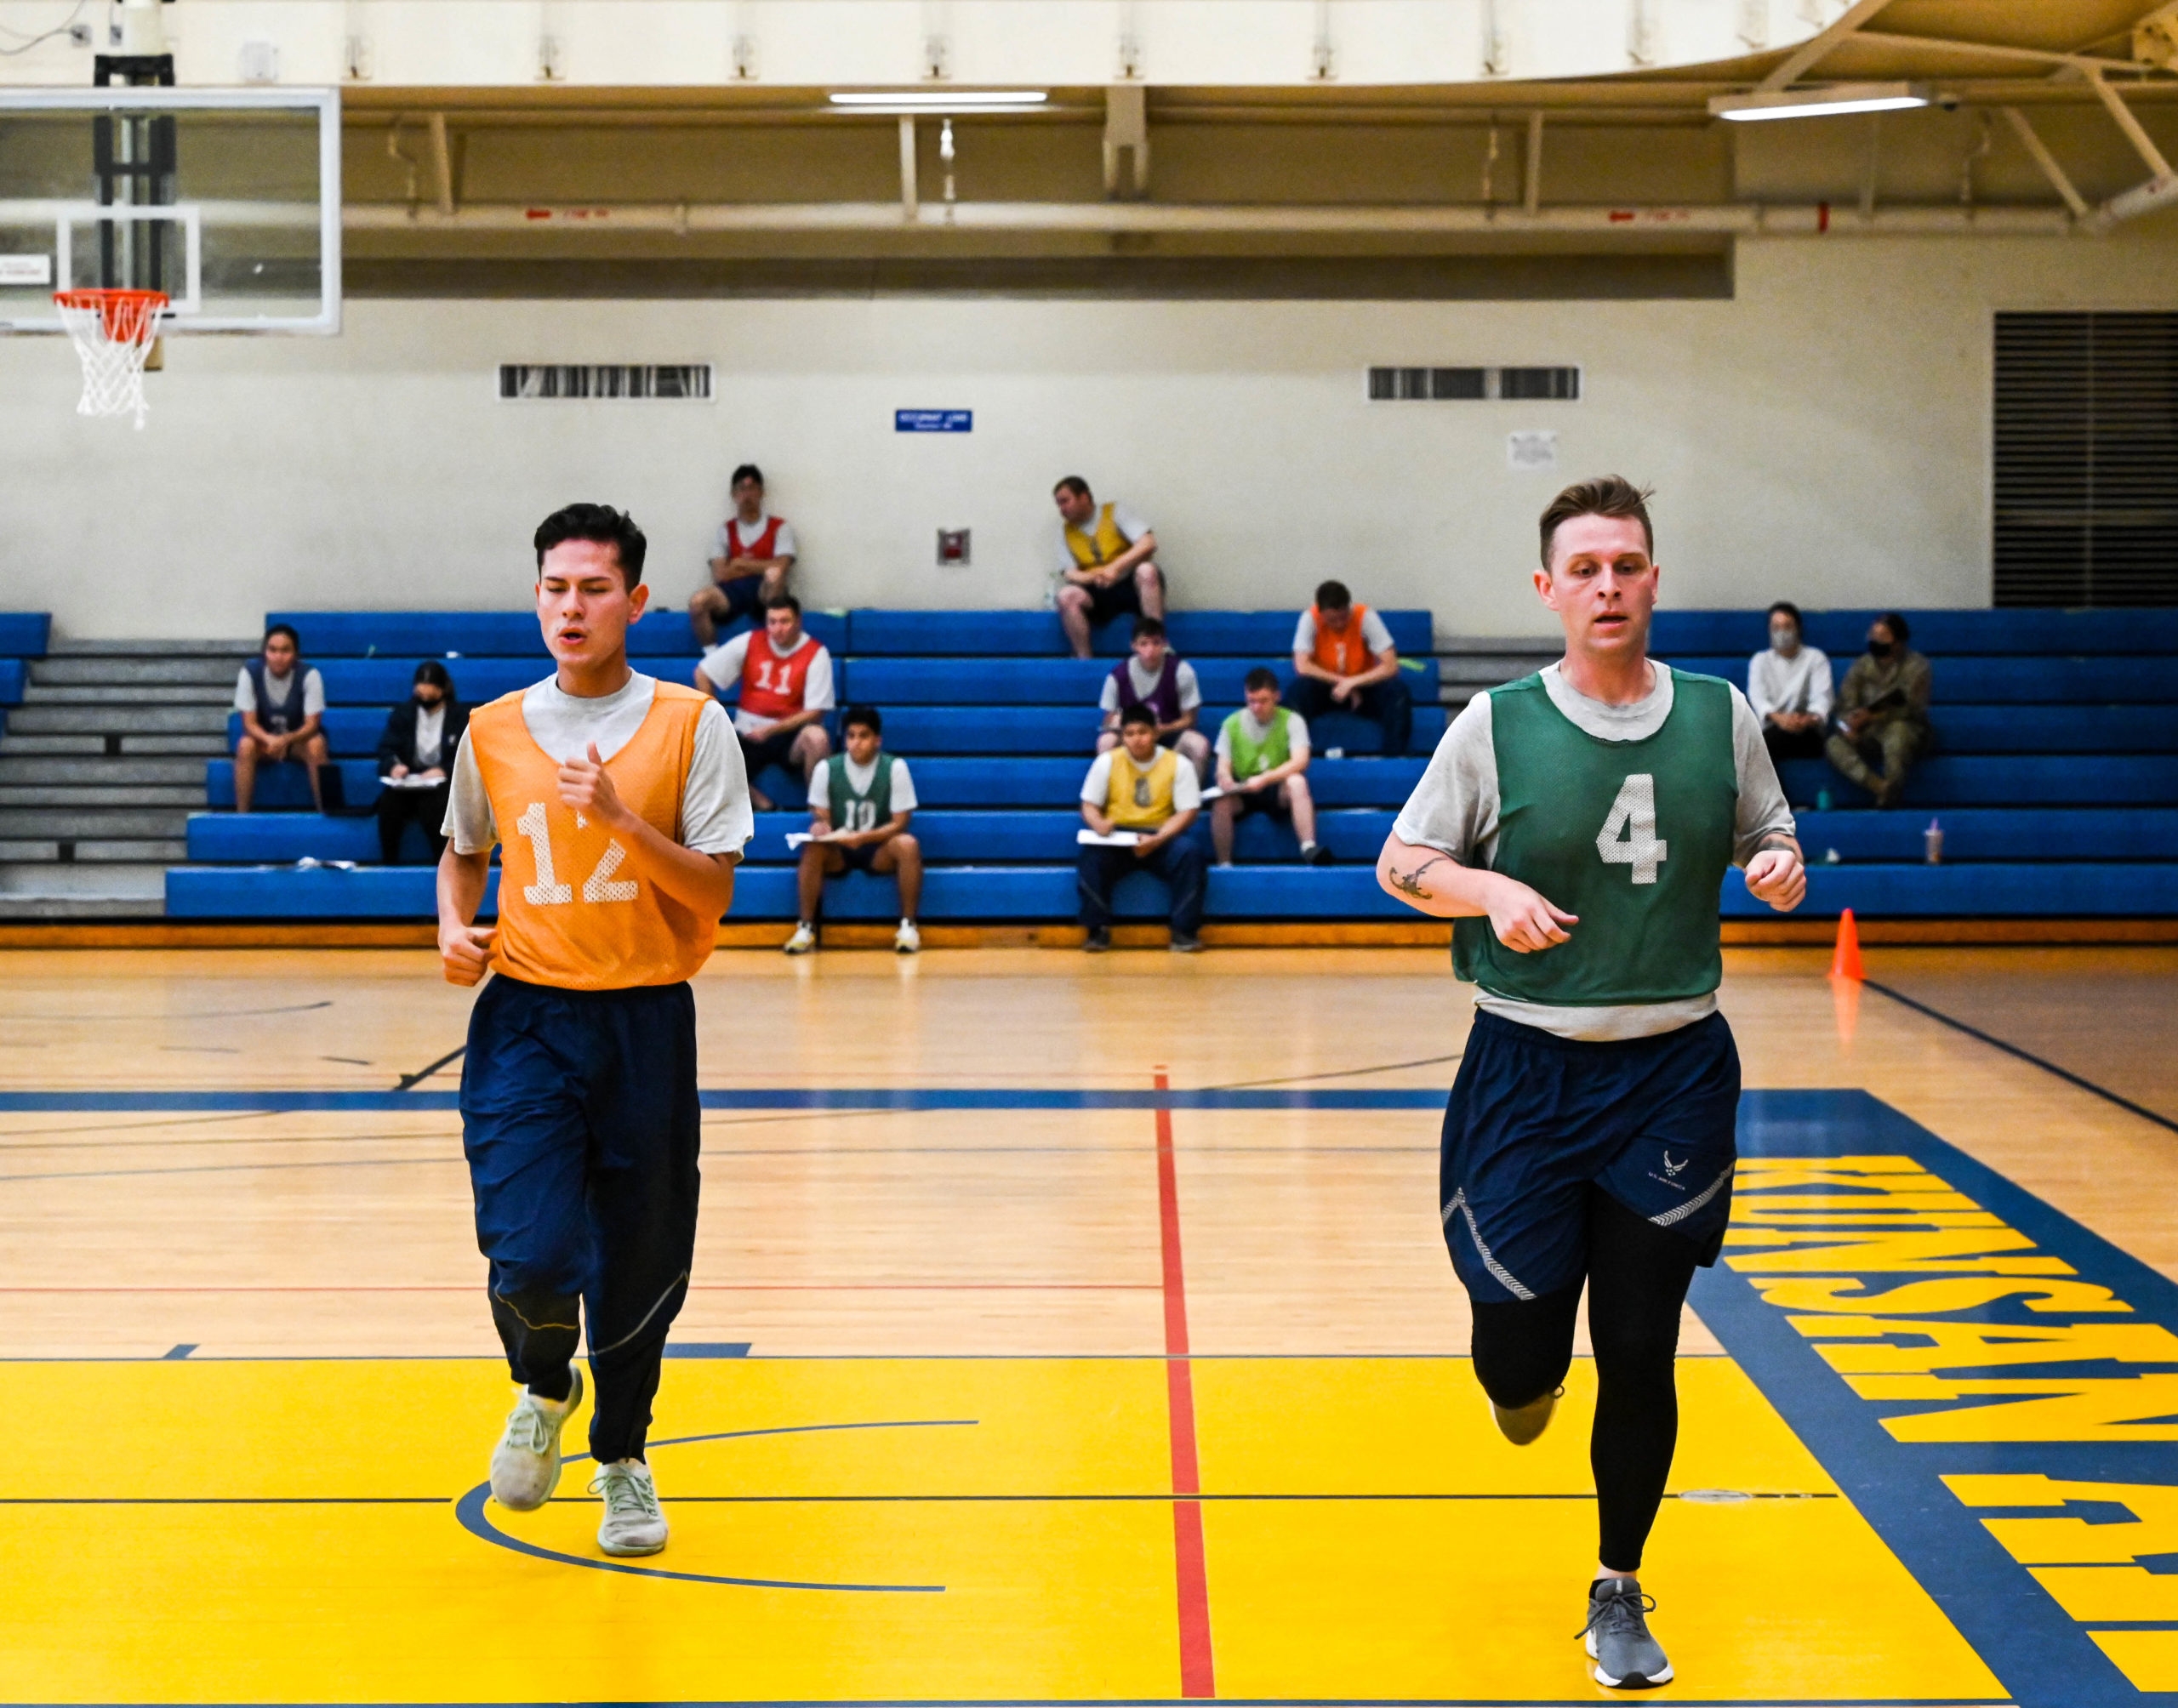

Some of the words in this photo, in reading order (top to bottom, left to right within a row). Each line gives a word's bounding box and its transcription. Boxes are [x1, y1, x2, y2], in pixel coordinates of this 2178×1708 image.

[755, 660, 791, 695] 11
[845, 800, 876, 831] 10
[1596, 773, 1667, 885] 4
[1722, 1155, 2178, 1443] KUNSAN
